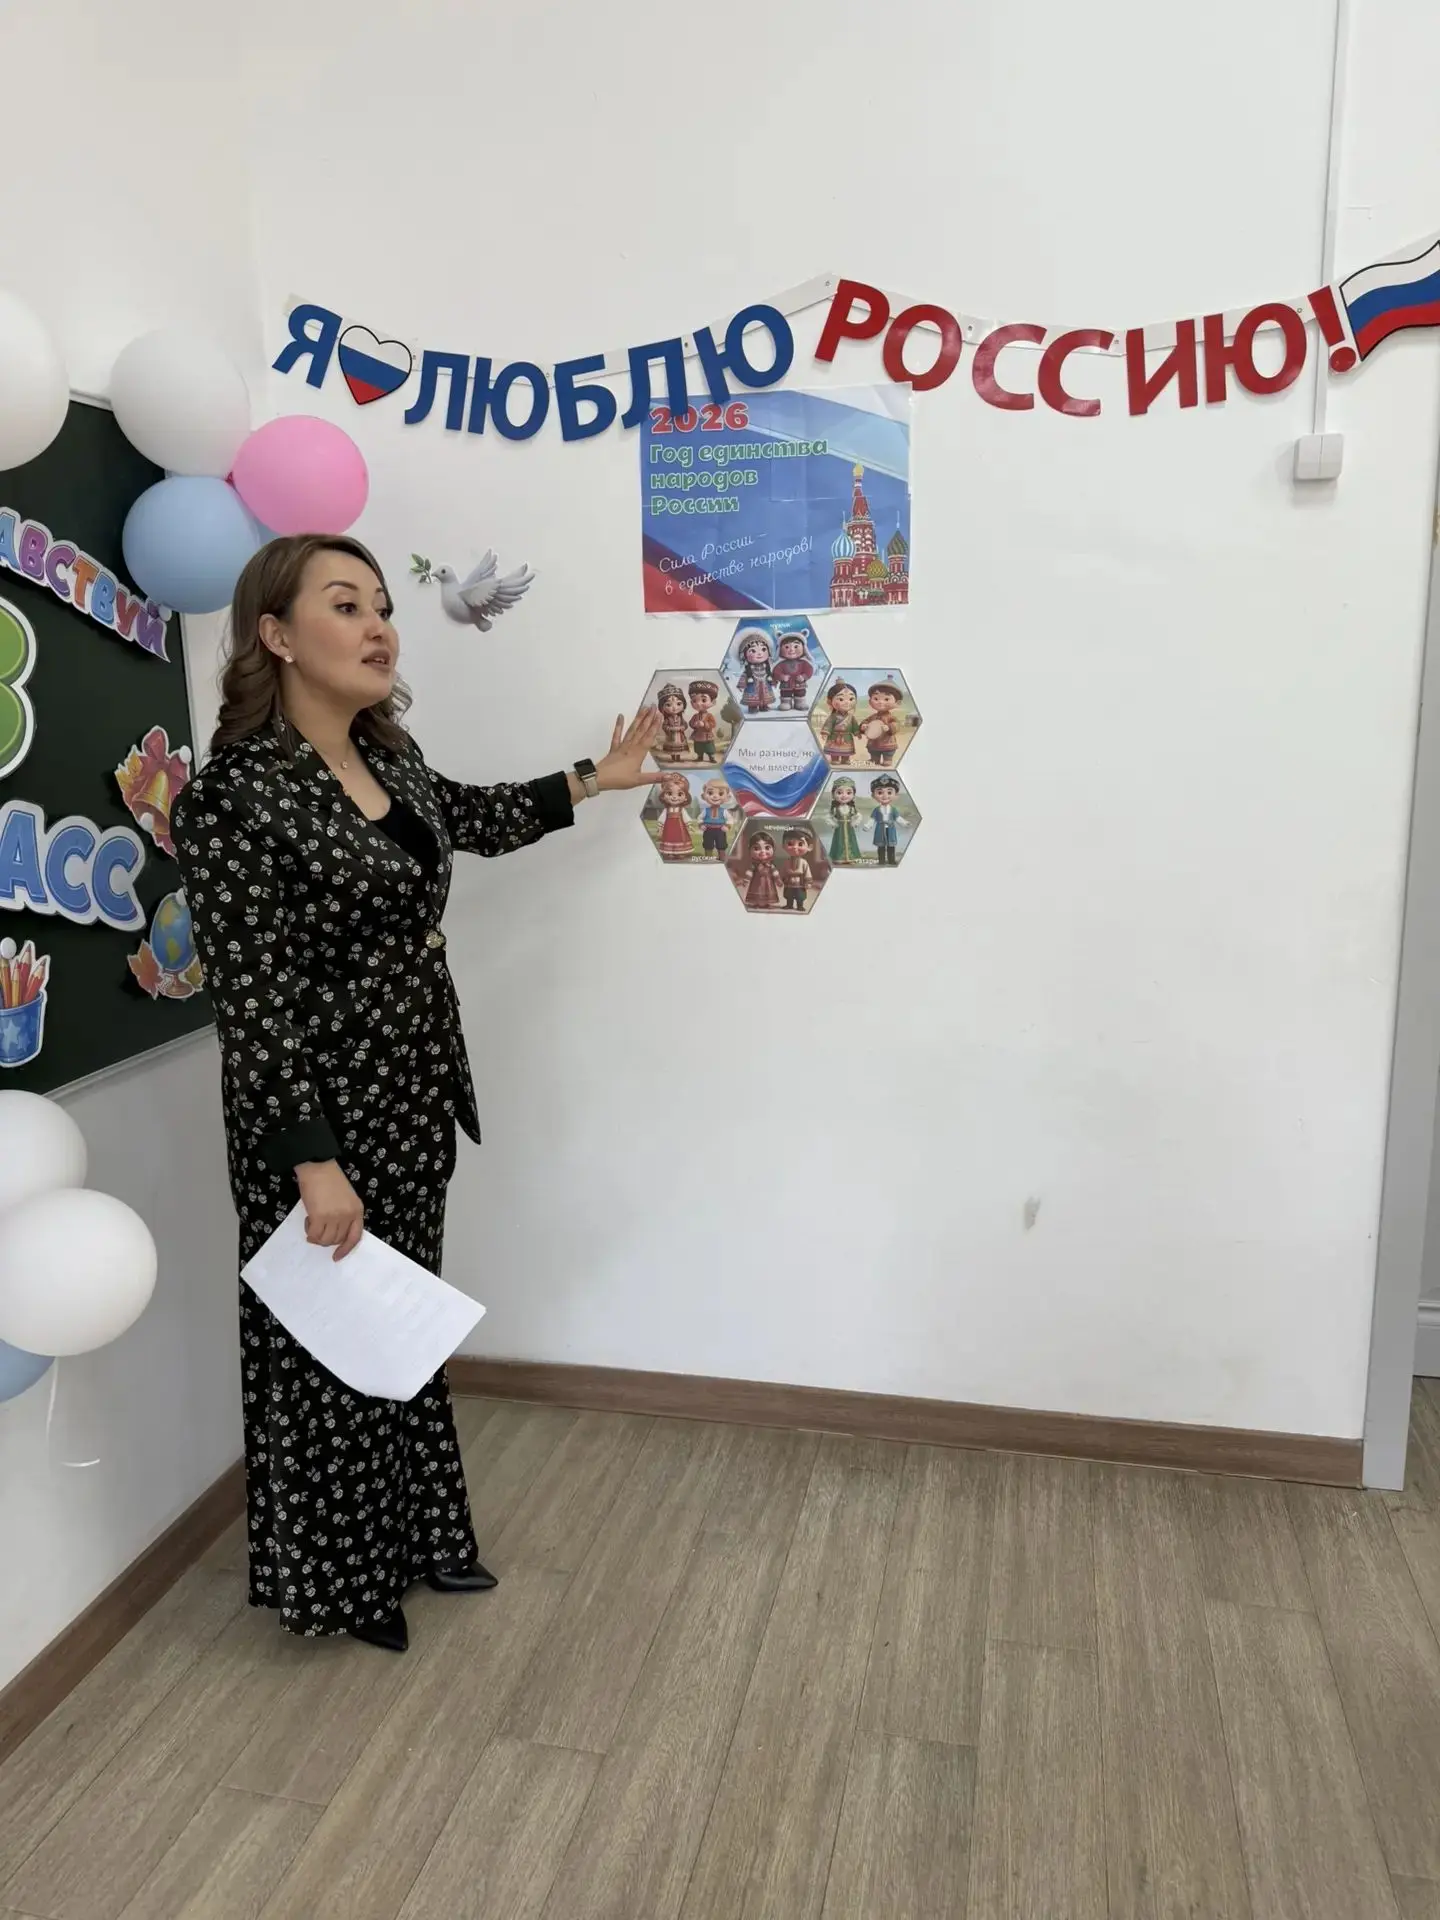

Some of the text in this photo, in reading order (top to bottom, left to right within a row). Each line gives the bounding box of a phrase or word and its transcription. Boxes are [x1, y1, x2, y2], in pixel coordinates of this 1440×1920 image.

[272, 279, 1356, 441] Я ЛЮБЛЮ РОССИЮ!
[649, 402, 749, 434] 2026
[650, 439, 829, 467] Год единства
[650, 470, 758, 492] народов
[651, 496, 740, 515] России
[659, 557, 698, 573] Сила
[701, 535, 755, 560] России
[665, 535, 813, 595] в единстве народов!
[738, 748, 756, 757] Мы
